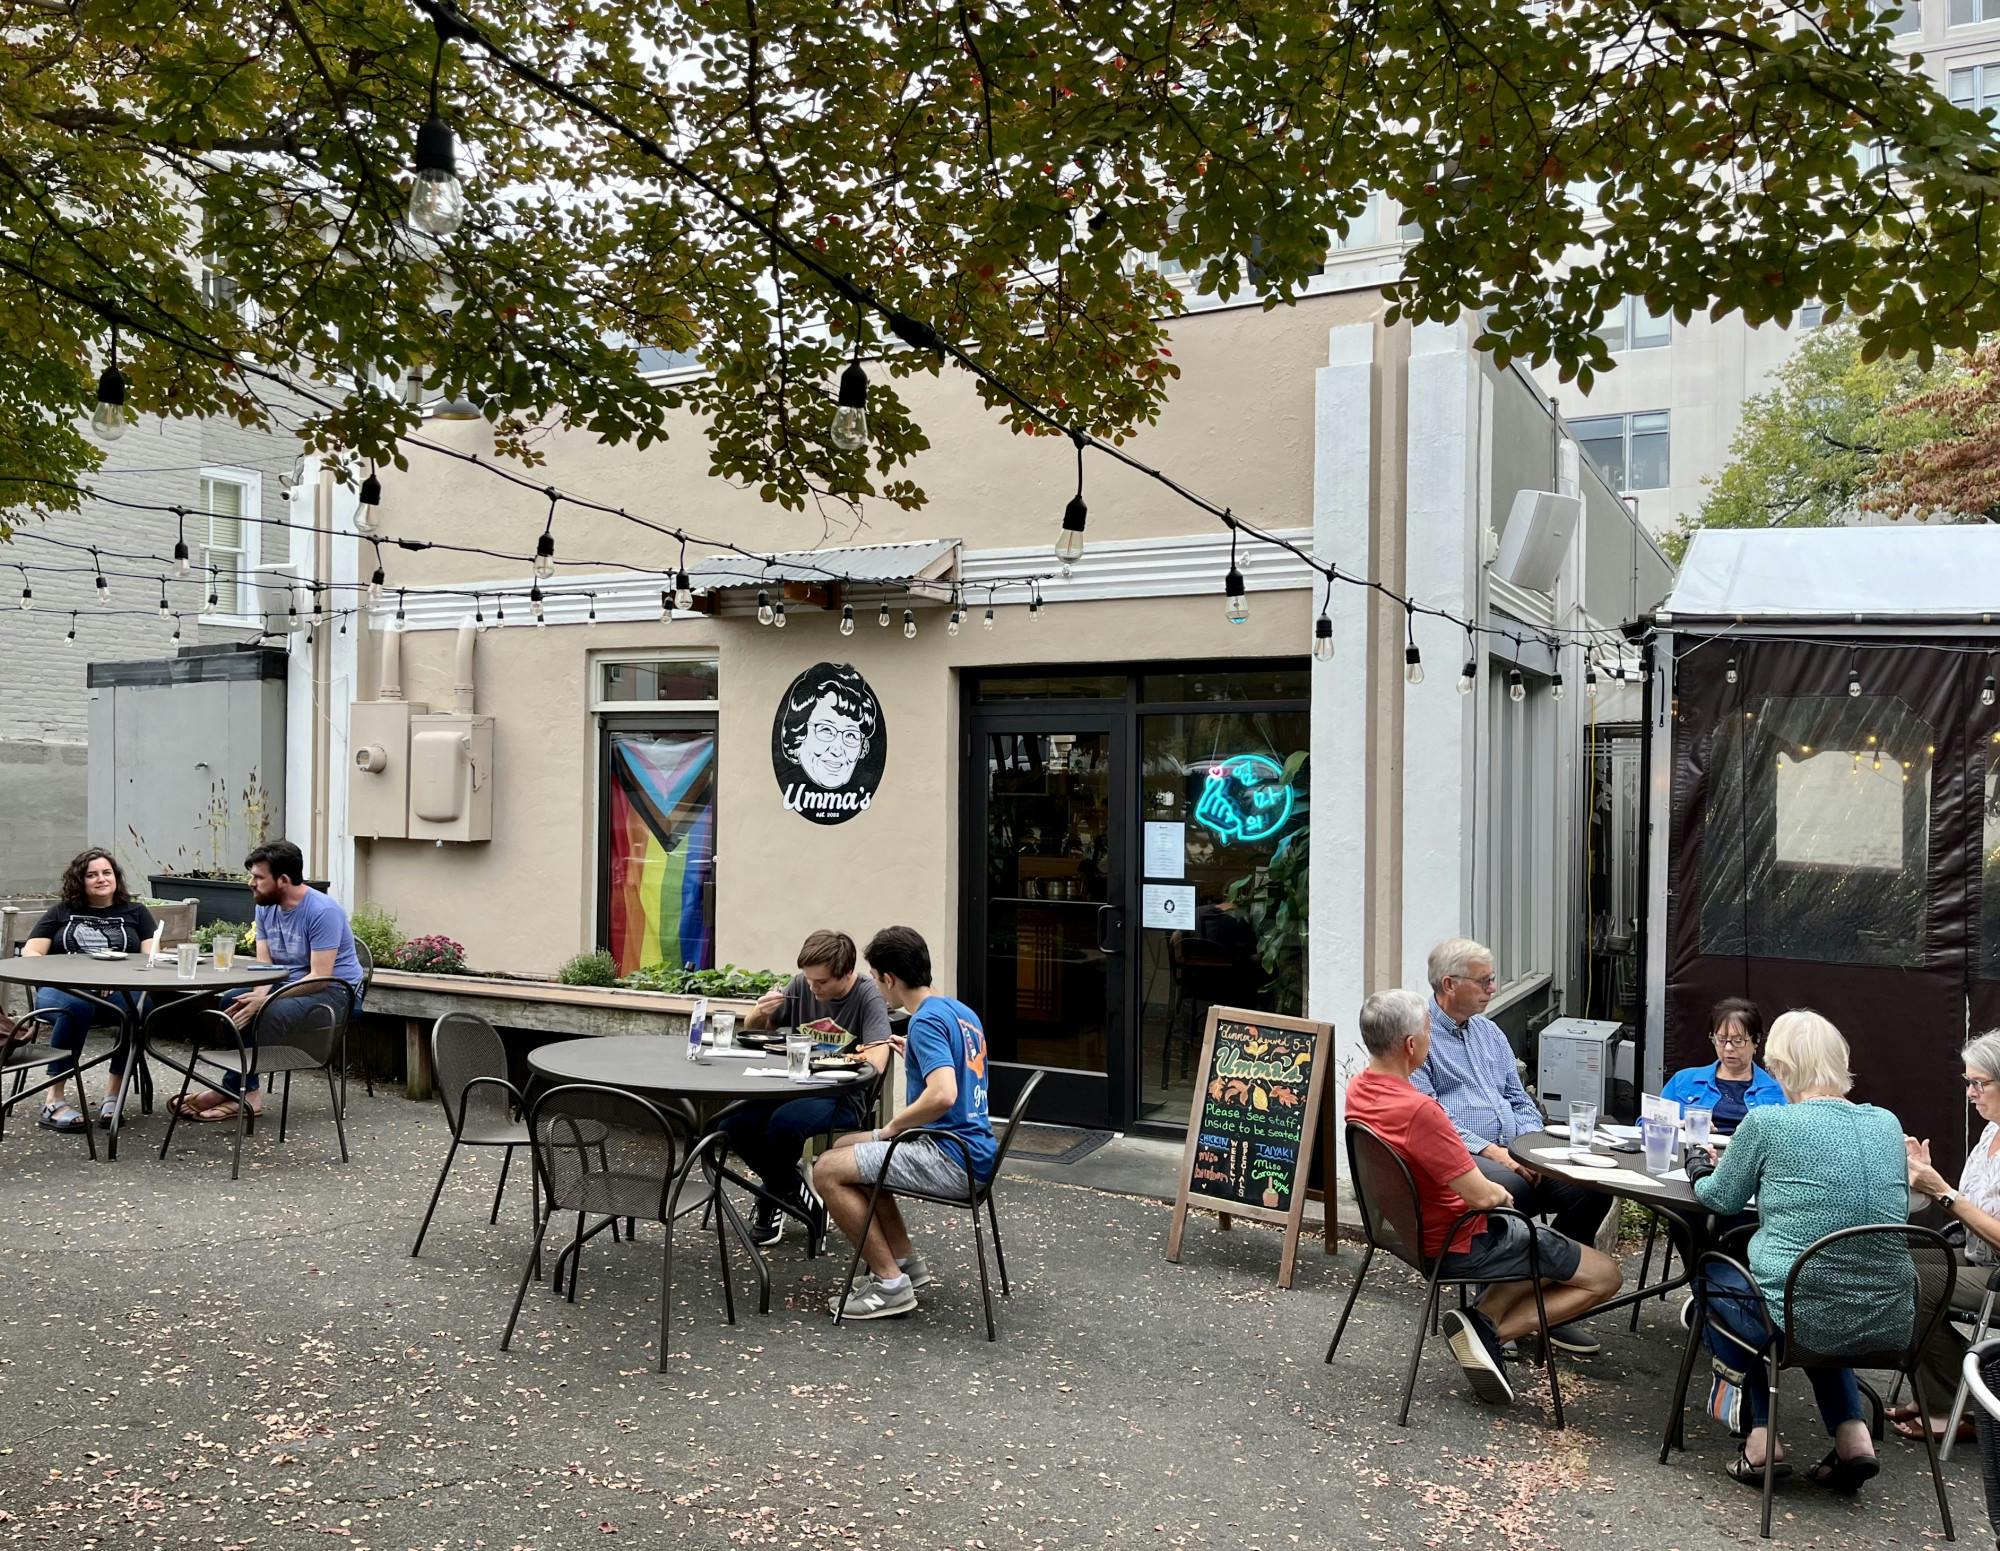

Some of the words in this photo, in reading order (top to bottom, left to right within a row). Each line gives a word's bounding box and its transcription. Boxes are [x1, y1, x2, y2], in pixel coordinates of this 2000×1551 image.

[782, 783, 872, 812] Umma's
[1221, 1024, 1253, 1042] dinner
[1257, 1036, 1290, 1047] served
[1293, 1038, 1311, 1054] 5-9
[1216, 1046, 1304, 1083] Umma's
[1205, 1103, 1241, 1118] Please
[1246, 1111, 1266, 1123] see
[1268, 1116, 1298, 1128] staff
[1204, 1119, 1235, 1132] inside
[1239, 1122, 1250, 1134] to
[1254, 1125, 1265, 1136] be
[1268, 1128, 1300, 1142] seated
[1229, 1139, 1238, 1186] WEEKLY
[1255, 1143, 1293, 1158] TAIYAKI
[1238, 1141, 1249, 1197] SPECIALS
[863, 1293, 886, 1311] N
